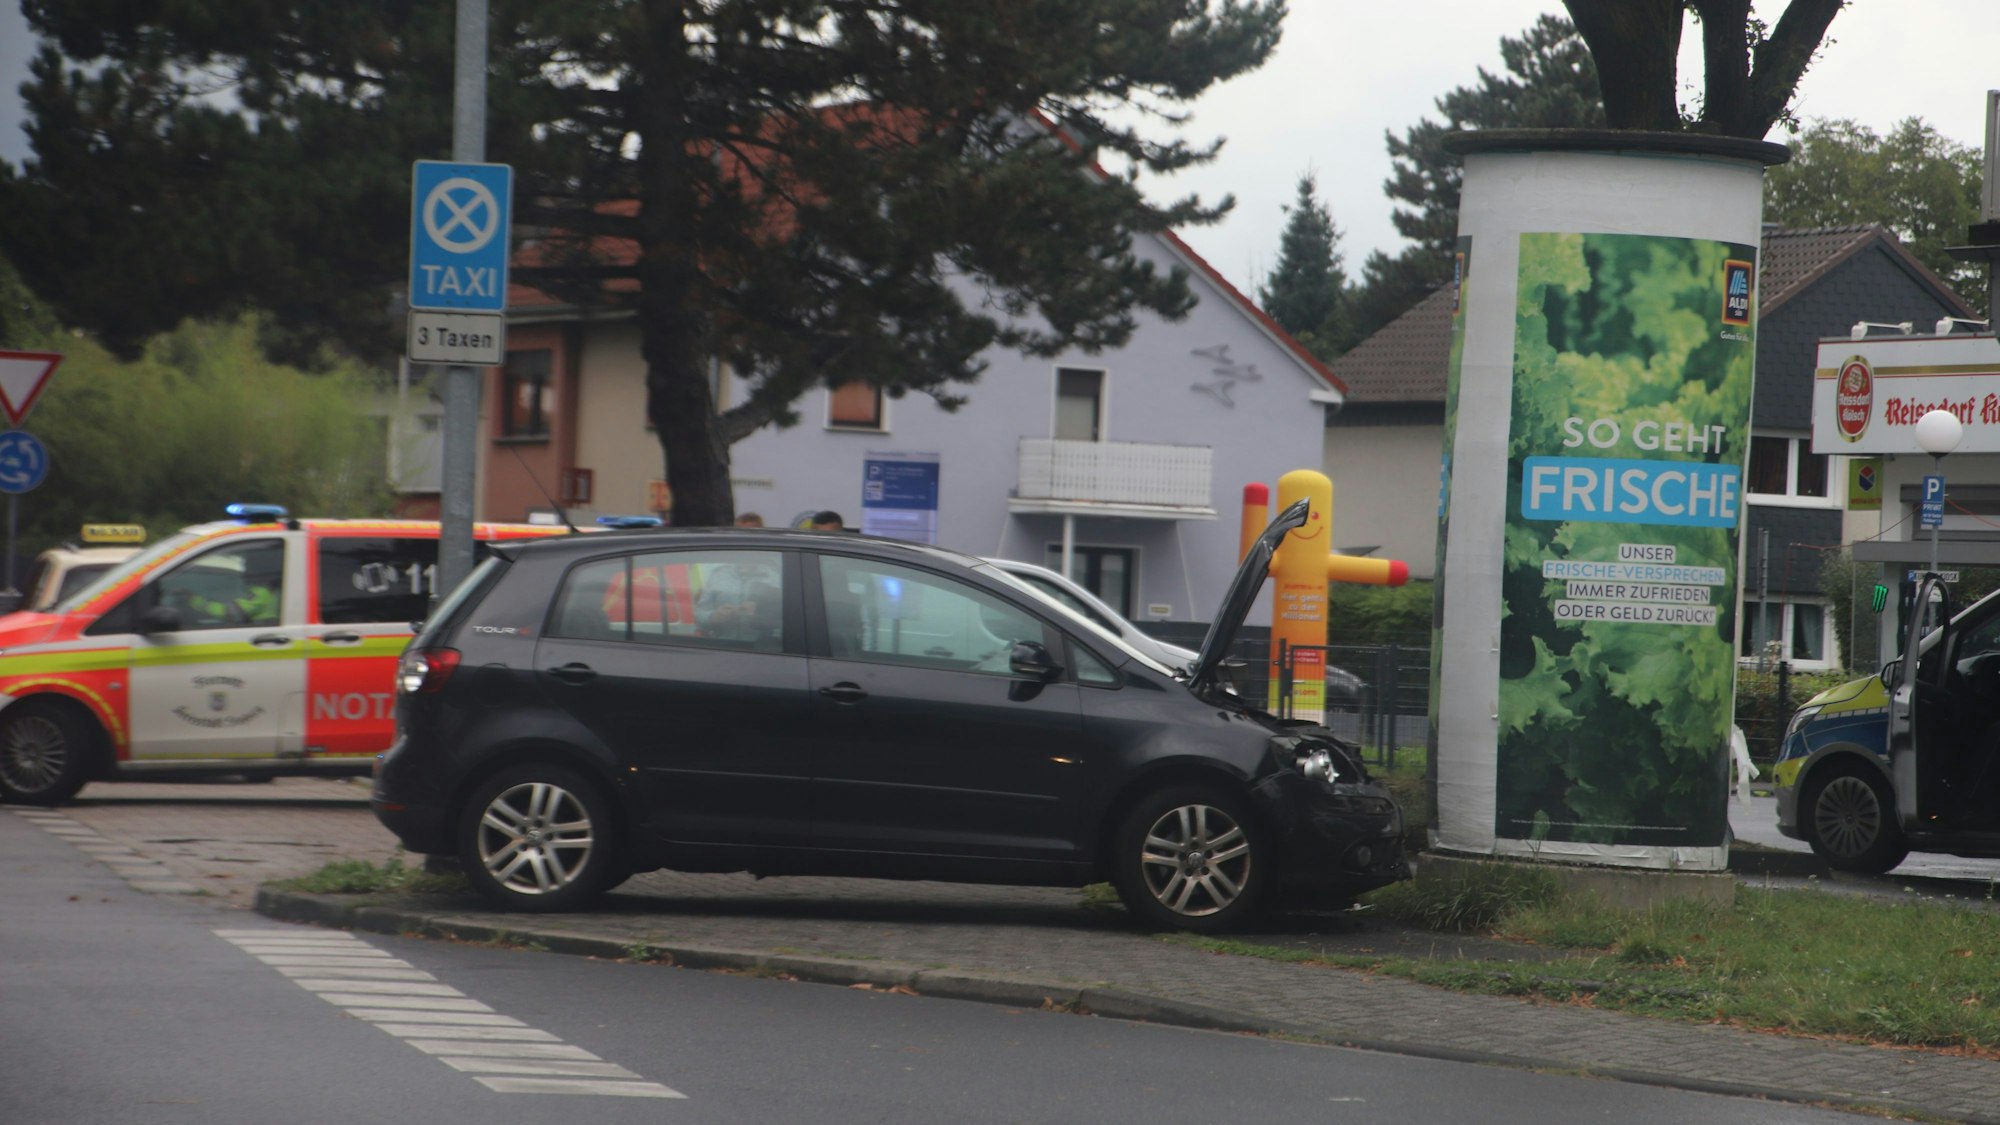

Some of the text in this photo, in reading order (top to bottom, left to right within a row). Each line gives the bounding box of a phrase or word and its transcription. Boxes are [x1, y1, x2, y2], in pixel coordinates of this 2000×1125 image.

[420, 264, 497, 297] TAXI
[1728, 297, 1748, 310] ALDI
[418, 326, 492, 348] 3 Taxen
[1839, 393, 1871, 406] Reissdorf
[1979, 393, 2000, 425] K
[1562, 417, 1726, 454] SO GEHT
[1530, 466, 1736, 519] FRISCHE
[1927, 478, 1940, 500] P
[1621, 546, 1674, 561] UNSER
[1569, 583, 1709, 602] IMMER ZUFRIEDEN
[1557, 603, 1606, 619] ODER
[1610, 606, 1652, 620] GELD
[472, 625, 516, 634] TOUR
